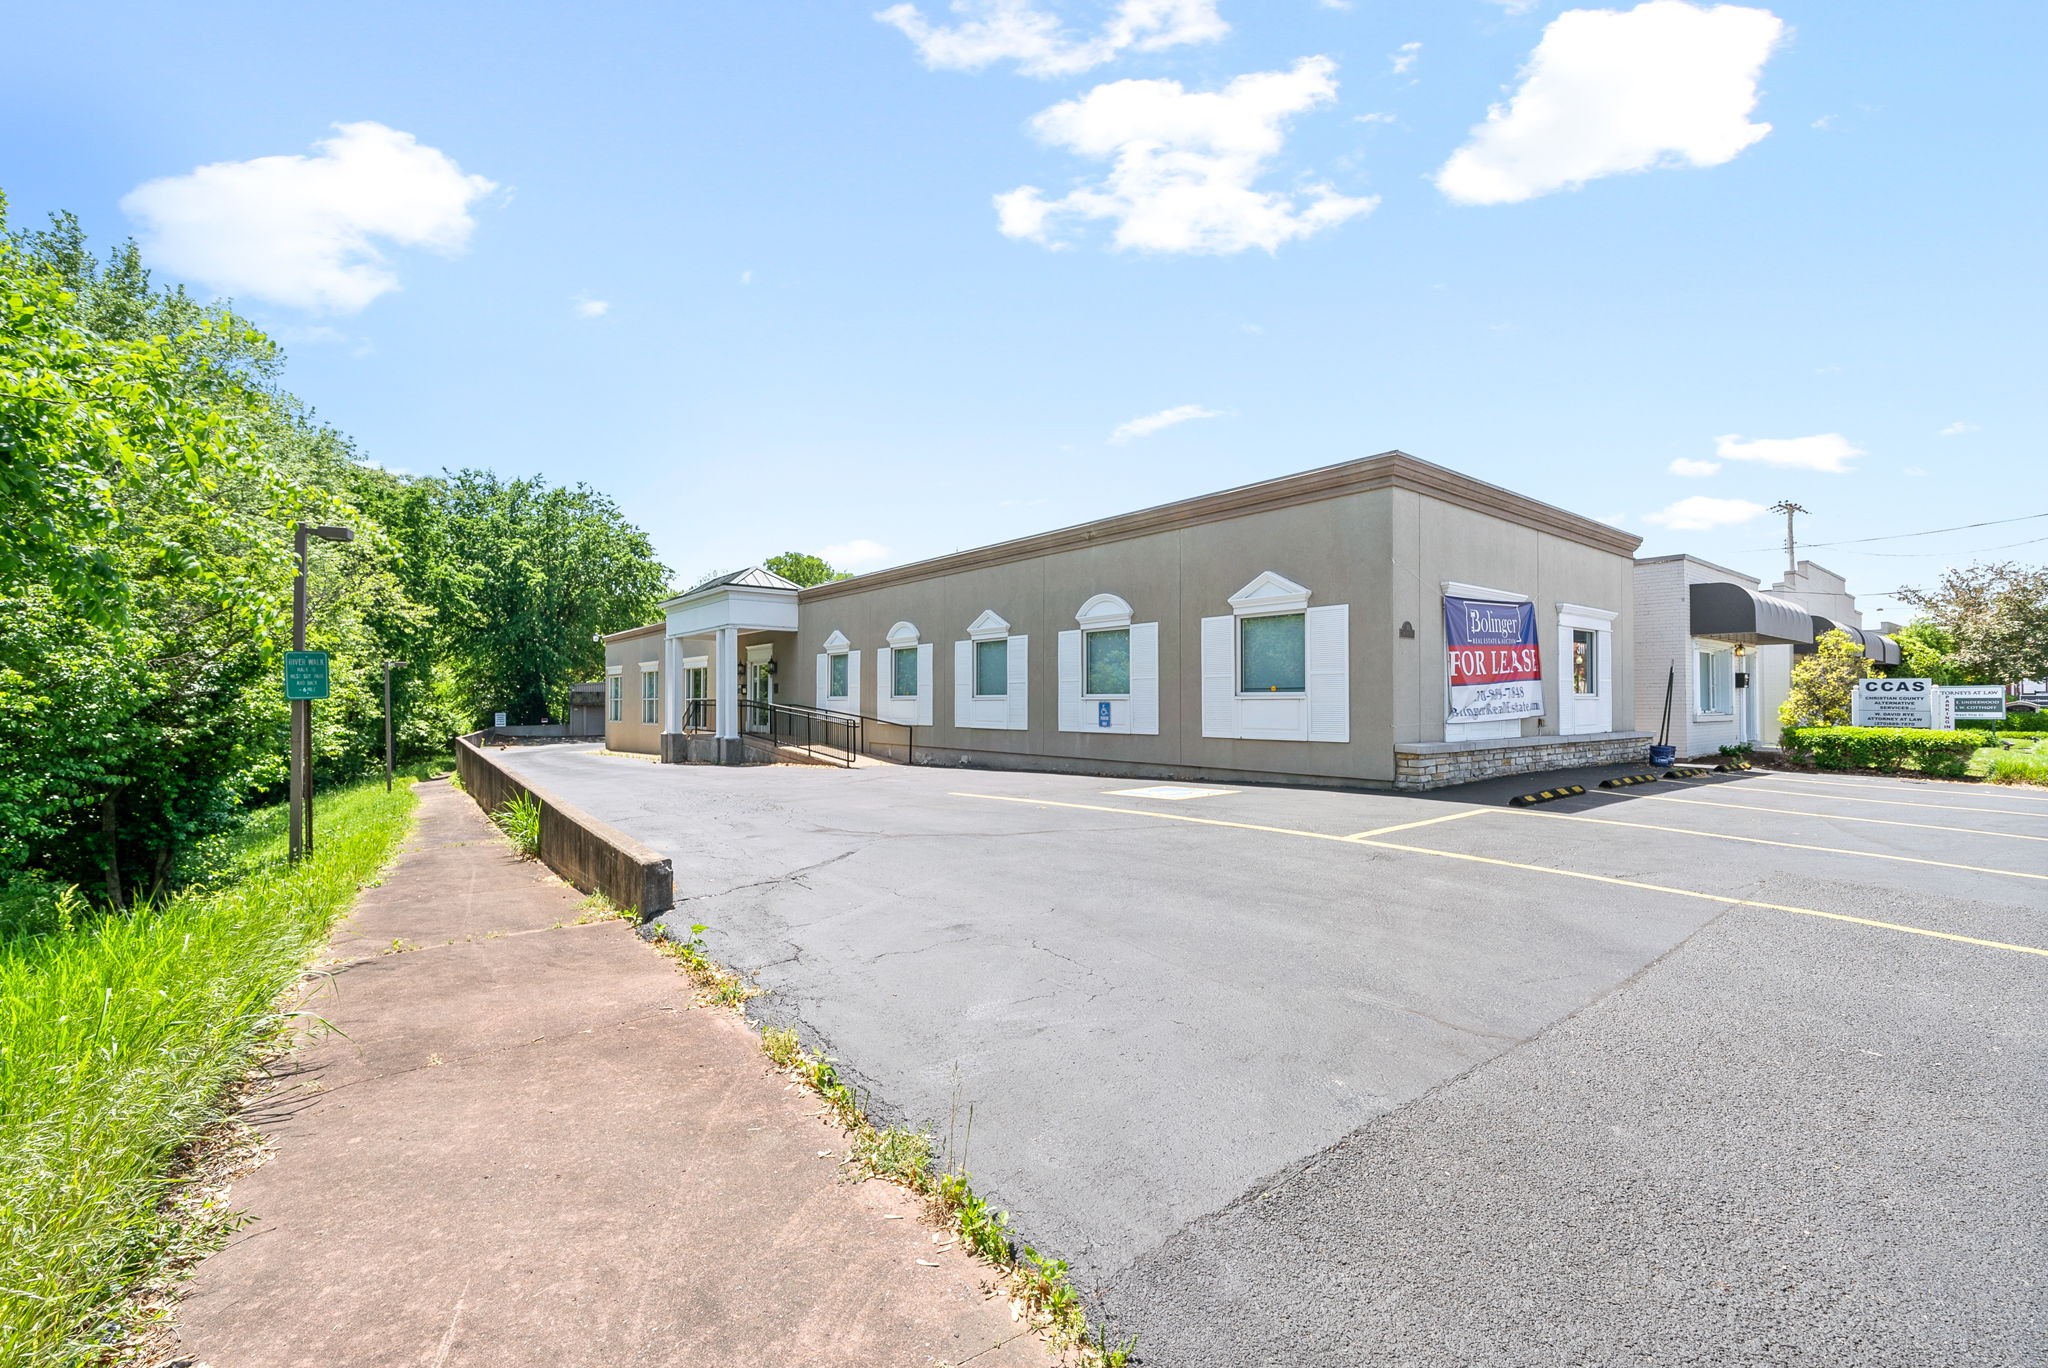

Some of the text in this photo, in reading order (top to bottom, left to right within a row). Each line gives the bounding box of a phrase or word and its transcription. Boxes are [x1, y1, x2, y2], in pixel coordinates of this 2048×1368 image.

[1470, 609, 1517, 638] Bolinger
[1449, 649, 1538, 676] FOR LEASE
[1865, 681, 1925, 692] CCAS
